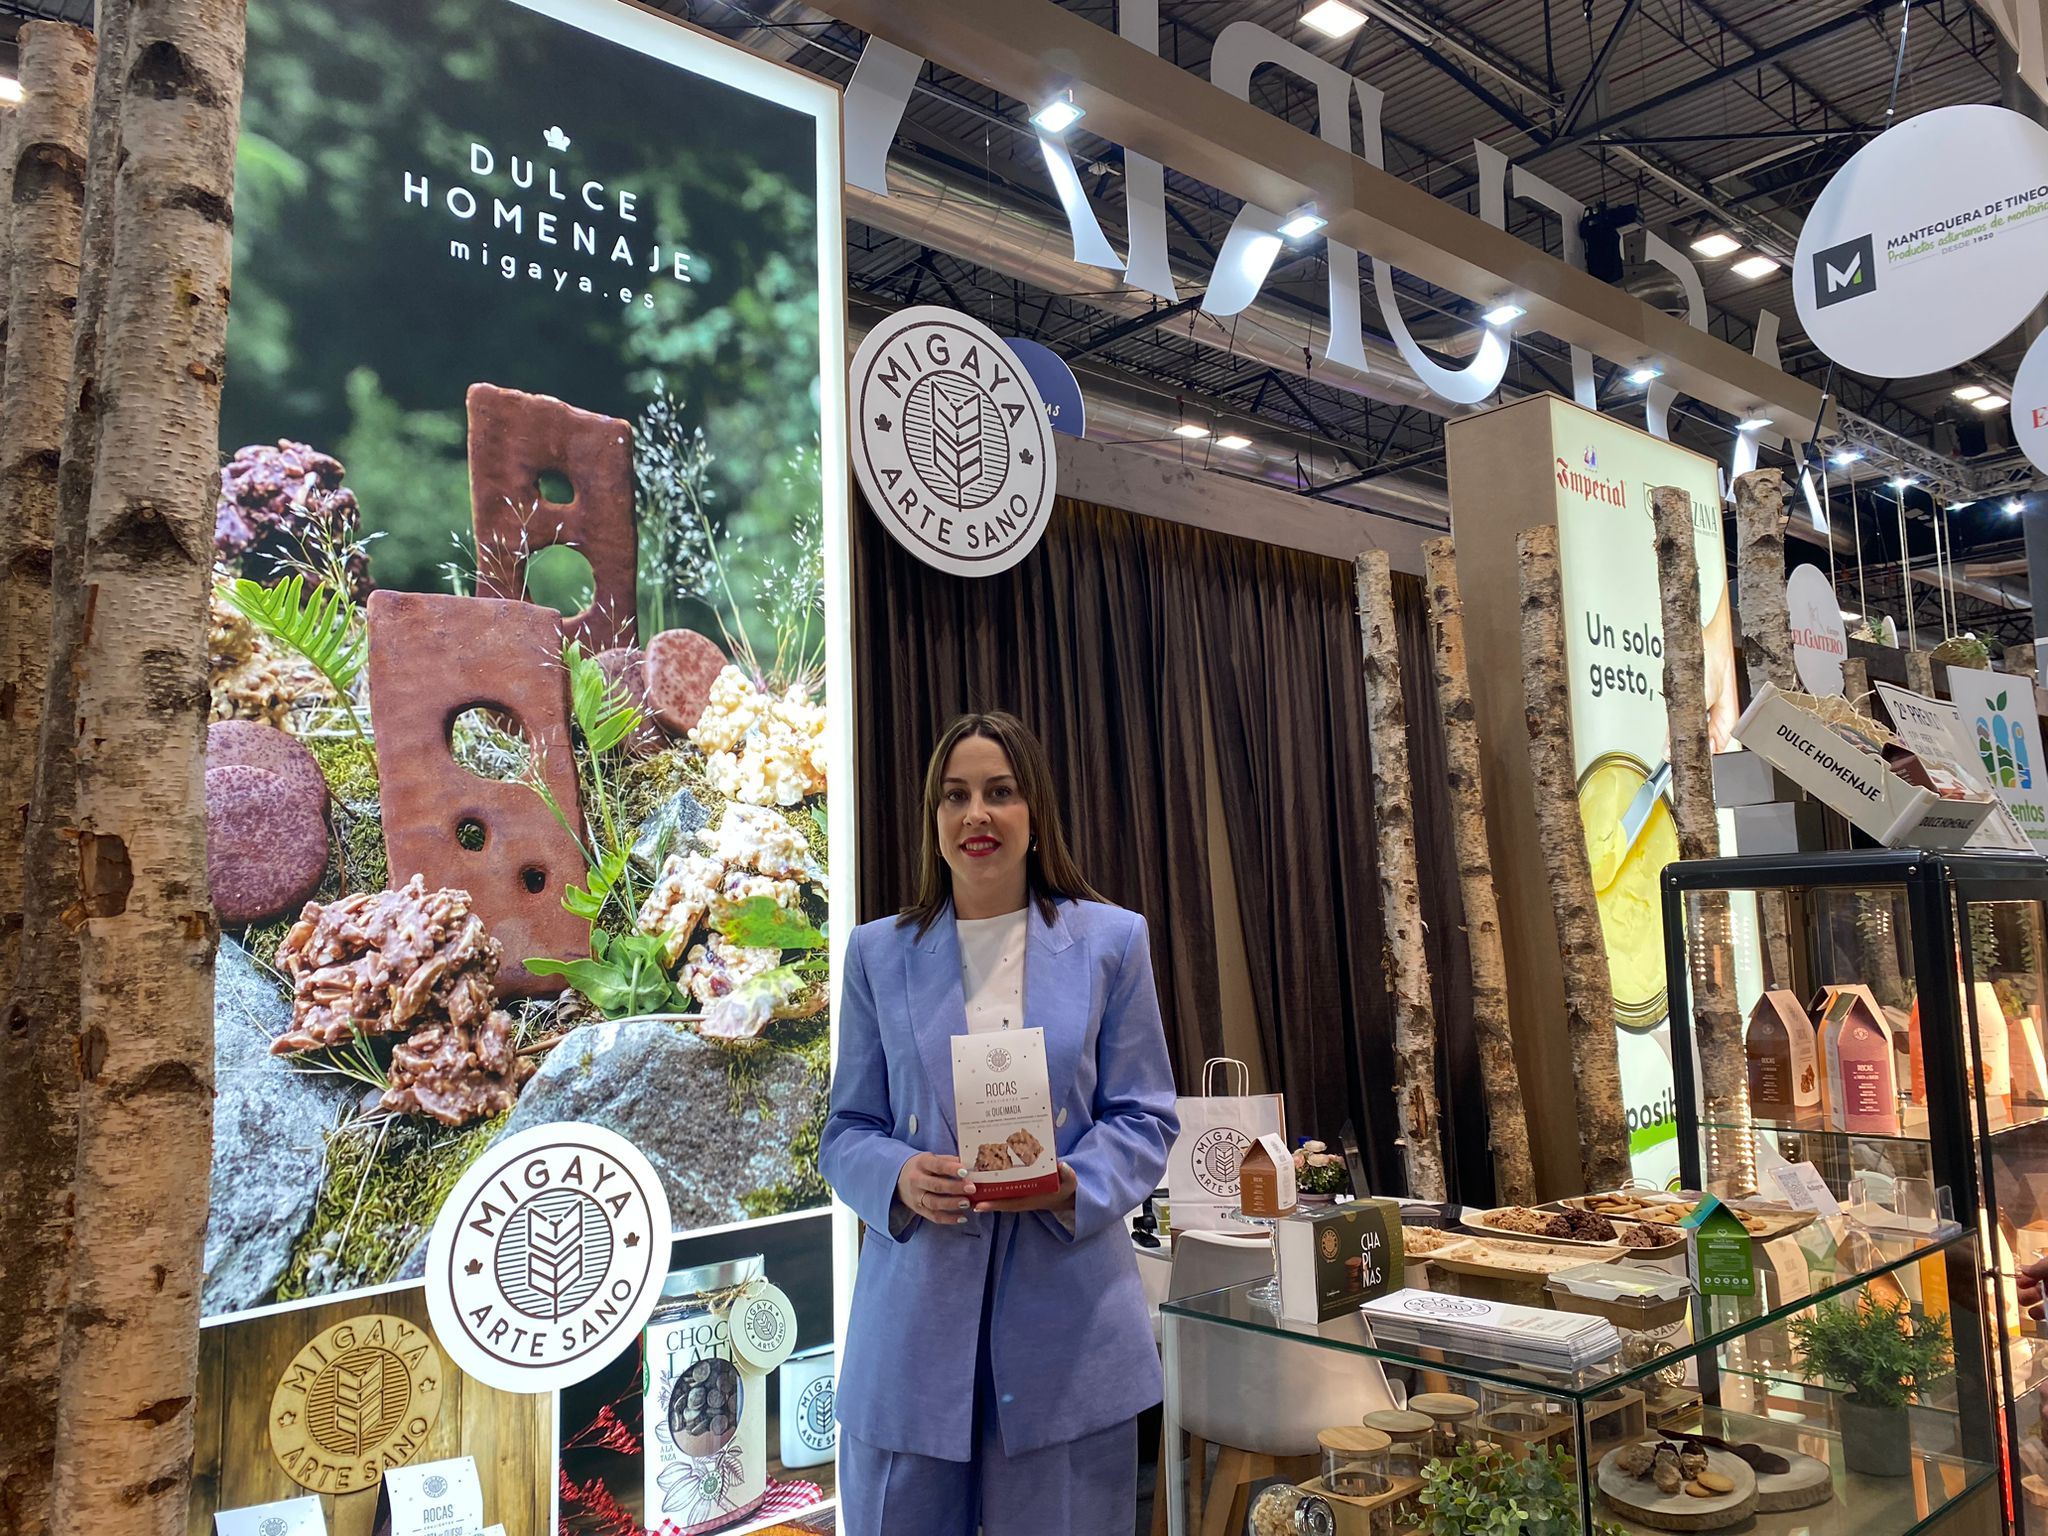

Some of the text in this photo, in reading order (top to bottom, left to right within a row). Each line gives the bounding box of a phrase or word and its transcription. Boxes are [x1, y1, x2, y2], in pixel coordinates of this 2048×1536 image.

[470, 142, 637, 222] DULCE
[403, 171, 692, 283] HOMENAJE
[1886, 185, 2048, 250] MANTEQUERA DE TINEO
[1887, 241, 1936, 264] Productos
[1938, 222, 1987, 247] asturianos
[1990, 213, 2005, 229] de
[1941, 239, 1970, 255] DESDE
[449, 240, 656, 310] migaya.es
[877, 333, 1026, 428] MIGAYA
[1556, 457, 1627, 509] Imperial
[880, 468, 1029, 550] ARTE SANO
[1692, 500, 1718, 532] ZANA
[1585, 610, 1662, 658] Un solo
[1589, 662, 1654, 702] gesto,
[1776, 723, 1814, 758] DULCE
[1814, 749, 1882, 802] HOMENAJE
[2009, 798, 2046, 823] entos
[985, 1080, 1018, 1098] ROCAS
[991, 1104, 1022, 1117] QUEIMADA
[1626, 1086, 1677, 1145] posib
[468, 1154, 632, 1238] MIGAYA
[1198, 1173, 1224, 1194] ARTE
[1227, 1183, 1241, 1195] SA
[1360, 1231, 1381, 1251] CHA
[1361, 1251, 1372, 1270] PI
[1362, 1266, 1382, 1288] NAS
[468, 1278, 632, 1358] ARTE SANO
[747, 1301, 773, 1330] MIGAYA
[666, 1320, 729, 1351] CHOC
[757, 1341, 776, 1350] ARTE
[282, 1319, 429, 1395] MIGAYA
[800, 1381, 833, 1409] MIGA
[281, 1416, 428, 1490] ARTE SANO
[800, 1429, 836, 1448] ARTE SA
[659, 1453, 677, 1463] TAZA
[423, 1503, 454, 1524] ROCAS
